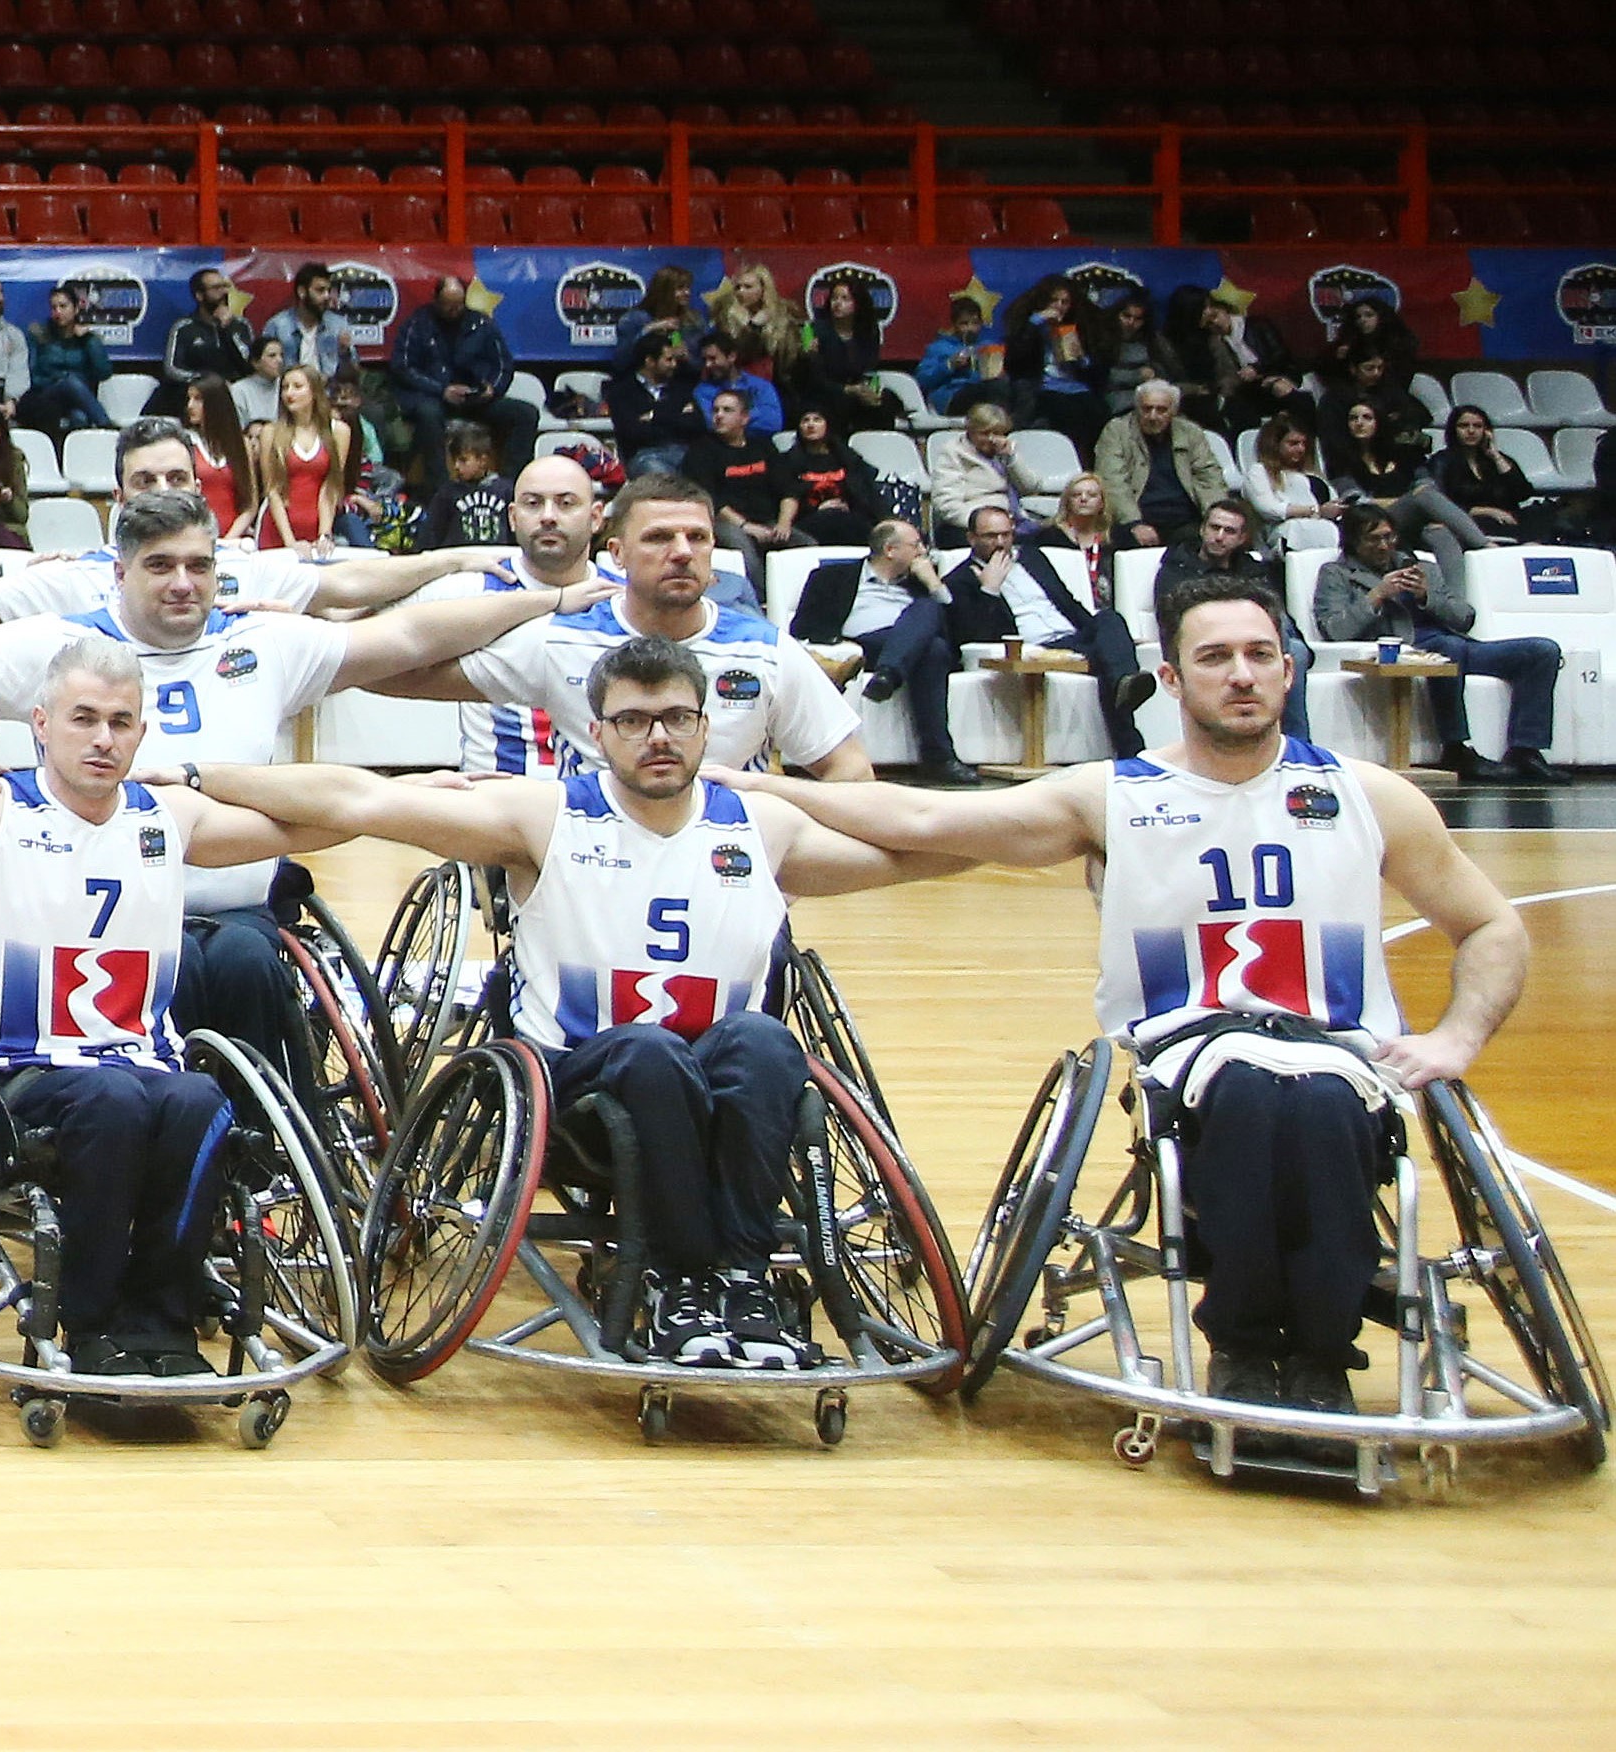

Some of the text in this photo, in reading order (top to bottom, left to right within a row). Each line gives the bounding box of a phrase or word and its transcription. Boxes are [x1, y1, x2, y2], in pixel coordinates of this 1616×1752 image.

[156, 680, 201, 734] 9
[1580, 671, 1598, 683] 12
[1199, 843, 1294, 912] 10
[86, 878, 121, 938] 7
[646, 898, 690, 962] 5
